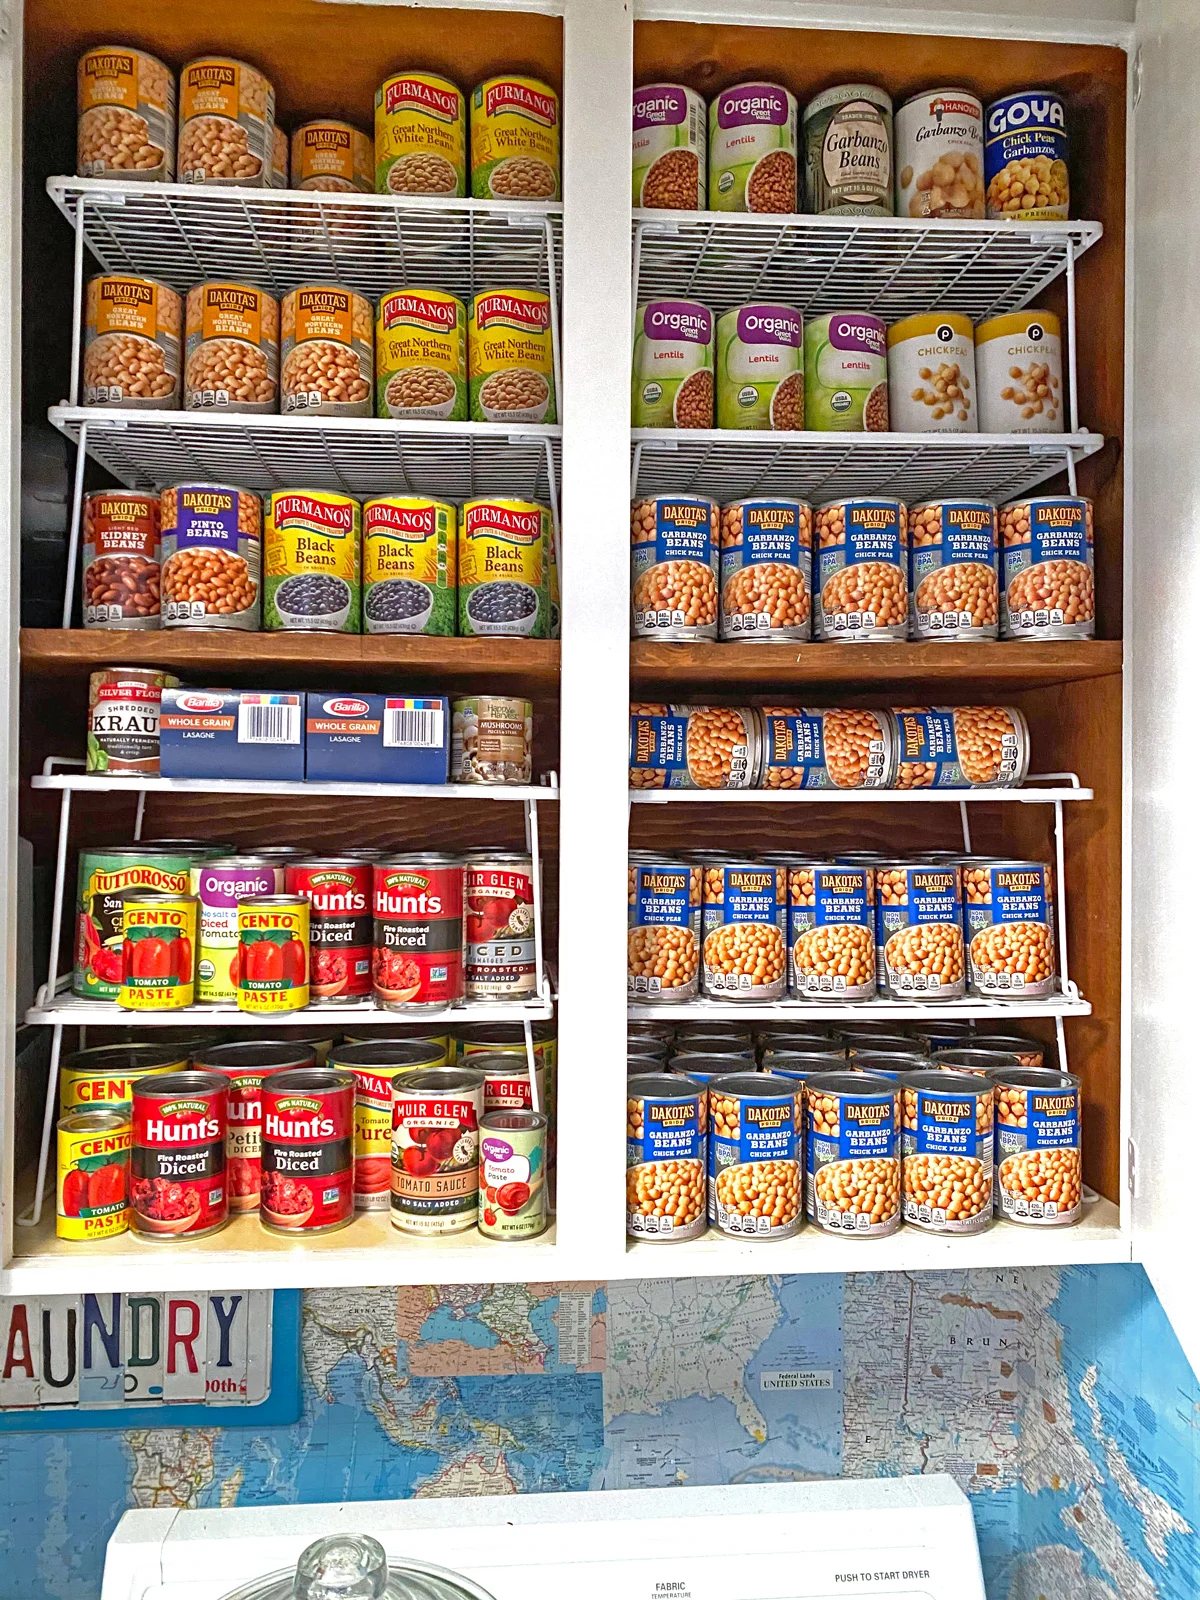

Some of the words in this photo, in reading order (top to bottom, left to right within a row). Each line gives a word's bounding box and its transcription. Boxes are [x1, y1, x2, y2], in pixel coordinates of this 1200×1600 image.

[190, 68, 233, 86] DAKOTA'S
[387, 82, 457, 116] FURMANO'S
[487, 85, 556, 115] FURMANO'S
[723, 95, 783, 116] Organic
[989, 100, 1065, 133] GOYA
[392, 125, 416, 139] Great
[418, 123, 455, 143] Northern
[915, 123, 968, 143] Garbanzo
[307, 132, 348, 148] DAKOTA'S
[393, 134, 424, 146] White
[427, 134, 454, 151] Beans
[725, 136, 756, 148] Lentils
[827, 131, 889, 154] Garbanzo
[1003, 136, 1031, 149] Chick
[1034, 133, 1056, 145] Peas
[1003, 144, 1056, 160] Garbanzos
[839, 150, 881, 169] Beans
[104, 284, 151, 301] DAKOTA'S
[210, 290, 256, 308] DAKOTA'S
[302, 294, 347, 308] DAKOTA'S
[384, 298, 455, 326] FURMANO'S
[478, 298, 548, 326] FURMANO'S
[651, 310, 708, 332] Organic
[745, 315, 800, 337] Organic
[307, 327, 341, 337] BEANS
[837, 323, 887, 345] Organic
[389, 340, 411, 353] Great
[412, 338, 452, 352] Northern
[390, 349, 419, 361] White
[422, 347, 450, 362] Beans
[653, 349, 685, 361] Lentils
[748, 354, 780, 367] Lentils
[842, 361, 871, 374] Lentils
[184, 493, 231, 509] DAKOTA'S
[101, 502, 148, 518] DAKOTA'S
[276, 498, 350, 528] FURMANO'S
[664, 506, 707, 521] DAKOTA'S
[1038, 508, 1082, 521] DAKOTA'S
[190, 520, 224, 531] PINTO
[468, 508, 539, 536] FURMANO'S
[101, 531, 148, 542] KIDNEY
[187, 529, 229, 540] BEANS
[661, 531, 707, 541] GARBANZO
[1036, 531, 1083, 540] GARBANZO
[104, 539, 146, 550] BEANS
[297, 538, 336, 554] Black
[666, 539, 704, 548] BEANS
[1041, 539, 1080, 548] BEANS
[379, 545, 414, 559] Black
[486, 546, 523, 561] Black
[296, 552, 337, 567] Beans
[376, 557, 415, 571] Beans
[484, 559, 524, 573] Beans
[99, 688, 134, 699] SILVER
[135, 689, 161, 698] FLOS
[108, 704, 154, 715] SHREDDED
[187, 698, 220, 708] Barilla
[333, 702, 366, 713] Barilla
[93, 715, 159, 733] KRAU
[168, 718, 202, 727] WHOLE
[203, 719, 231, 728] GRAIN
[315, 722, 346, 731] WHOLE
[349, 723, 376, 732] GRAIN
[480, 721, 523, 731] MUSHROOMS
[183, 731, 216, 740] LASAGNE
[329, 736, 361, 744] LASAGNE
[637, 720, 650, 762] DAKOTA'S
[659, 720, 667, 765] GARBANZO
[667, 724, 675, 761] BEANS
[96, 870, 186, 892] TUTTOROSSO
[400, 874, 426, 887] NATURAL
[490, 873, 525, 891] GLEN
[731, 873, 771, 886] DAKOTA'S
[998, 873, 1040, 886] DAKOTA'S
[206, 876, 268, 899] Organic
[729, 896, 773, 904] GARBANZO
[996, 895, 1042, 904] GARBANZO
[733, 903, 769, 912] BEANS
[1002, 903, 1039, 911] BEANS
[128, 911, 182, 930] CENTO
[201, 919, 229, 930] Diced
[241, 914, 293, 933] CENTO
[383, 925, 396, 934] Fire
[397, 925, 429, 935] Roasted
[384, 933, 427, 947] Diced
[467, 945, 523, 957] ICED
[477, 966, 525, 974] ROASTED
[133, 977, 170, 987] TOMATO
[490, 974, 515, 982] ADDED
[247, 981, 283, 990] TOMATO
[129, 987, 174, 1000] PASTE
[243, 991, 288, 1003] PASTE
[177, 1102, 206, 1112] NATURAL
[1034, 1096, 1076, 1112] DAKOTA'S
[397, 1104, 427, 1120] MUIR
[434, 1104, 468, 1120] GLEN
[748, 1106, 790, 1121] DAKOTA'S
[360, 1116, 390, 1126] Tomato
[406, 1119, 455, 1128] ORGANIC
[1032, 1119, 1077, 1130] GARBANZO
[745, 1130, 792, 1141] GARBANZO
[1038, 1127, 1074, 1138] BEANS
[80, 1134, 131, 1156] CENTO
[750, 1138, 788, 1149] BEANS
[1036, 1138, 1058, 1146] CHICK
[1059, 1137, 1074, 1145] PEAS
[482, 1143, 510, 1156] Organic
[749, 1150, 772, 1158] CHICK
[772, 1149, 788, 1157] PEAS
[158, 1154, 174, 1163] Fire
[175, 1150, 209, 1162] Roasted
[160, 1161, 206, 1176] Diced
[276, 1157, 320, 1172] Diced
[488, 1165, 516, 1174] Tomato
[488, 1173, 508, 1182] Paste
[397, 1178, 431, 1194] TOMATO
[436, 1176, 468, 1192] SAUCE
[91, 1203, 125, 1216] TOMATO
[401, 1199, 411, 1207] NO
[413, 1200, 432, 1208] SALT
[434, 1199, 460, 1208] ADDED
[84, 1211, 131, 1231] PASTE
[348, 1307, 377, 1315] CHINA
[778, 1372, 799, 1380] Federal
[799, 1372, 816, 1380] Lands
[763, 1379, 798, 1389] UNITED
[798, 1378, 831, 1388] STATES
[834, 1573, 858, 1583] PUSH
[859, 1573, 872, 1582] TO
[872, 1571, 901, 1581] START
[902, 1569, 930, 1580] DRYER
[655, 1582, 686, 1591] FABRIC
